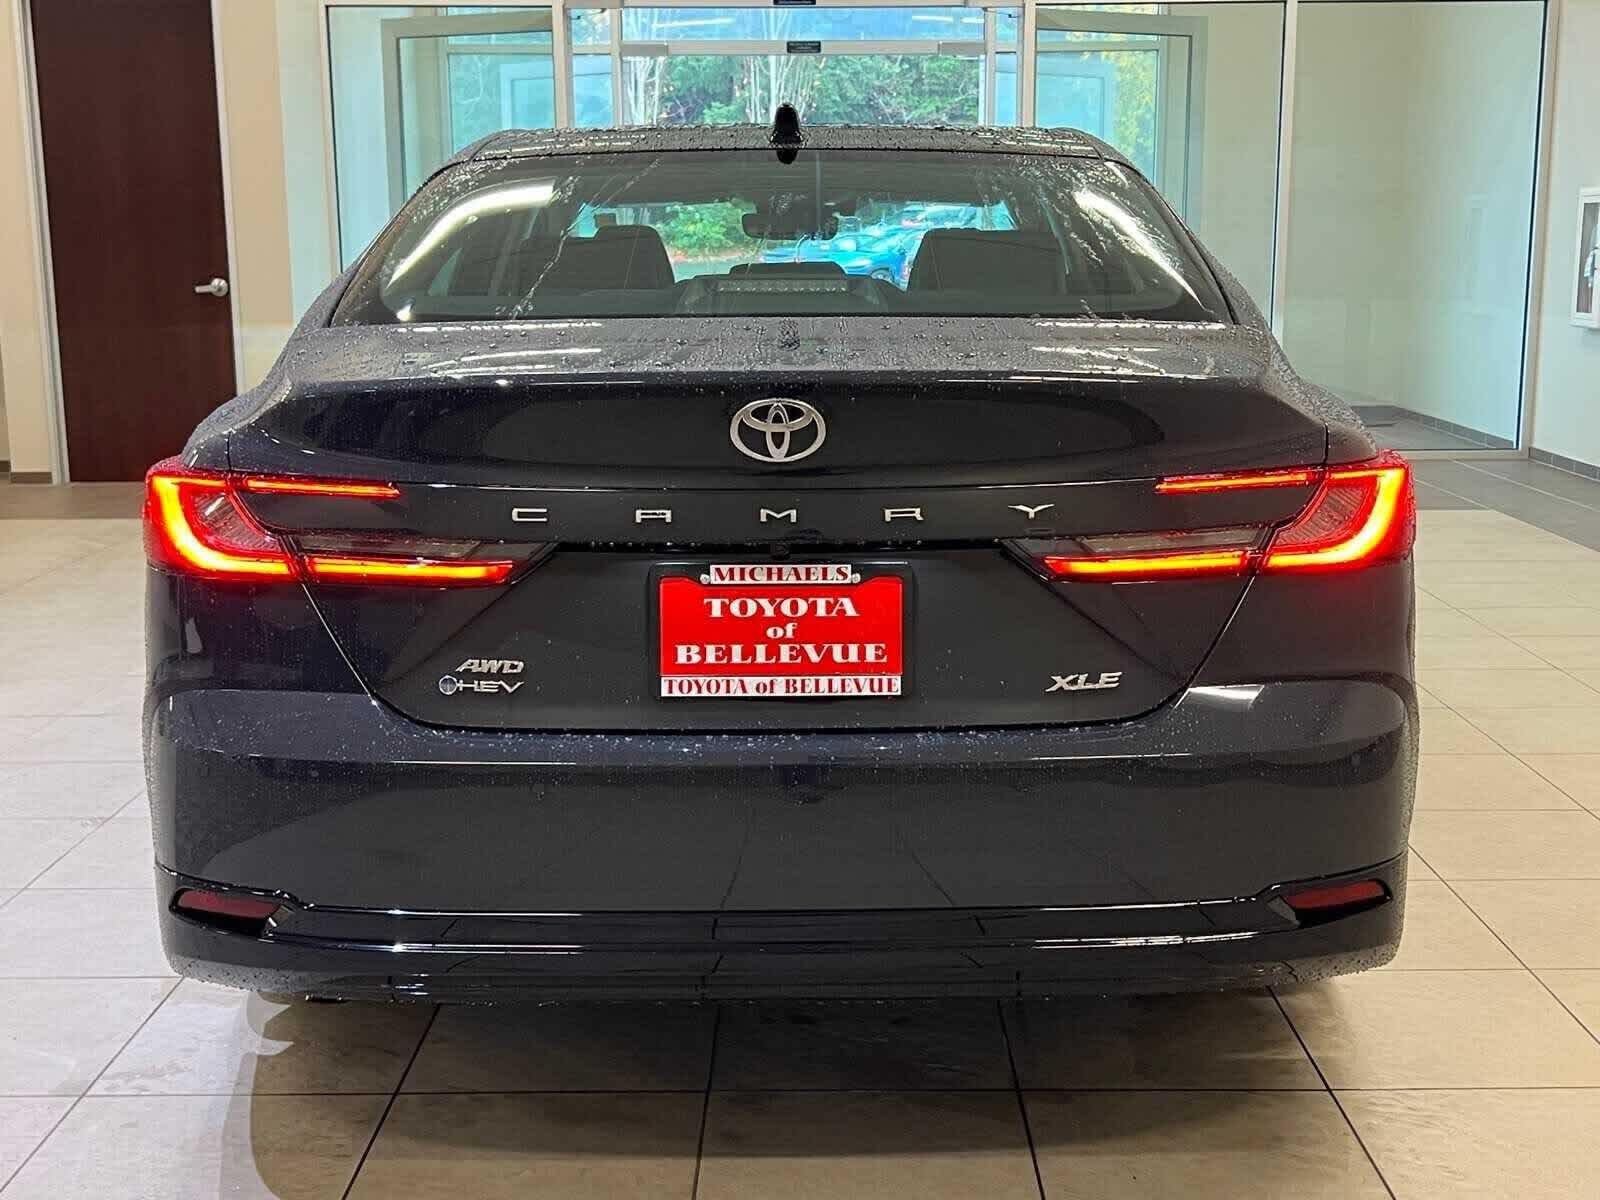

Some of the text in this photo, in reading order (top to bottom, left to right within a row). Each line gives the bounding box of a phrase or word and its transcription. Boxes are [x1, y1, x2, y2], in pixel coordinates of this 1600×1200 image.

[511, 503, 1055, 523] CAMRY
[714, 566, 849, 582] MICHAELS
[703, 597, 860, 618] TOYOTA
[766, 622, 798, 639] of
[675, 643, 888, 665] BELLEVUE
[456, 659, 525, 674] AWD
[457, 679, 525, 694] HEV
[663, 678, 899, 695] TOYOTA of BELLEVUE
[1045, 671, 1123, 692] XLE
